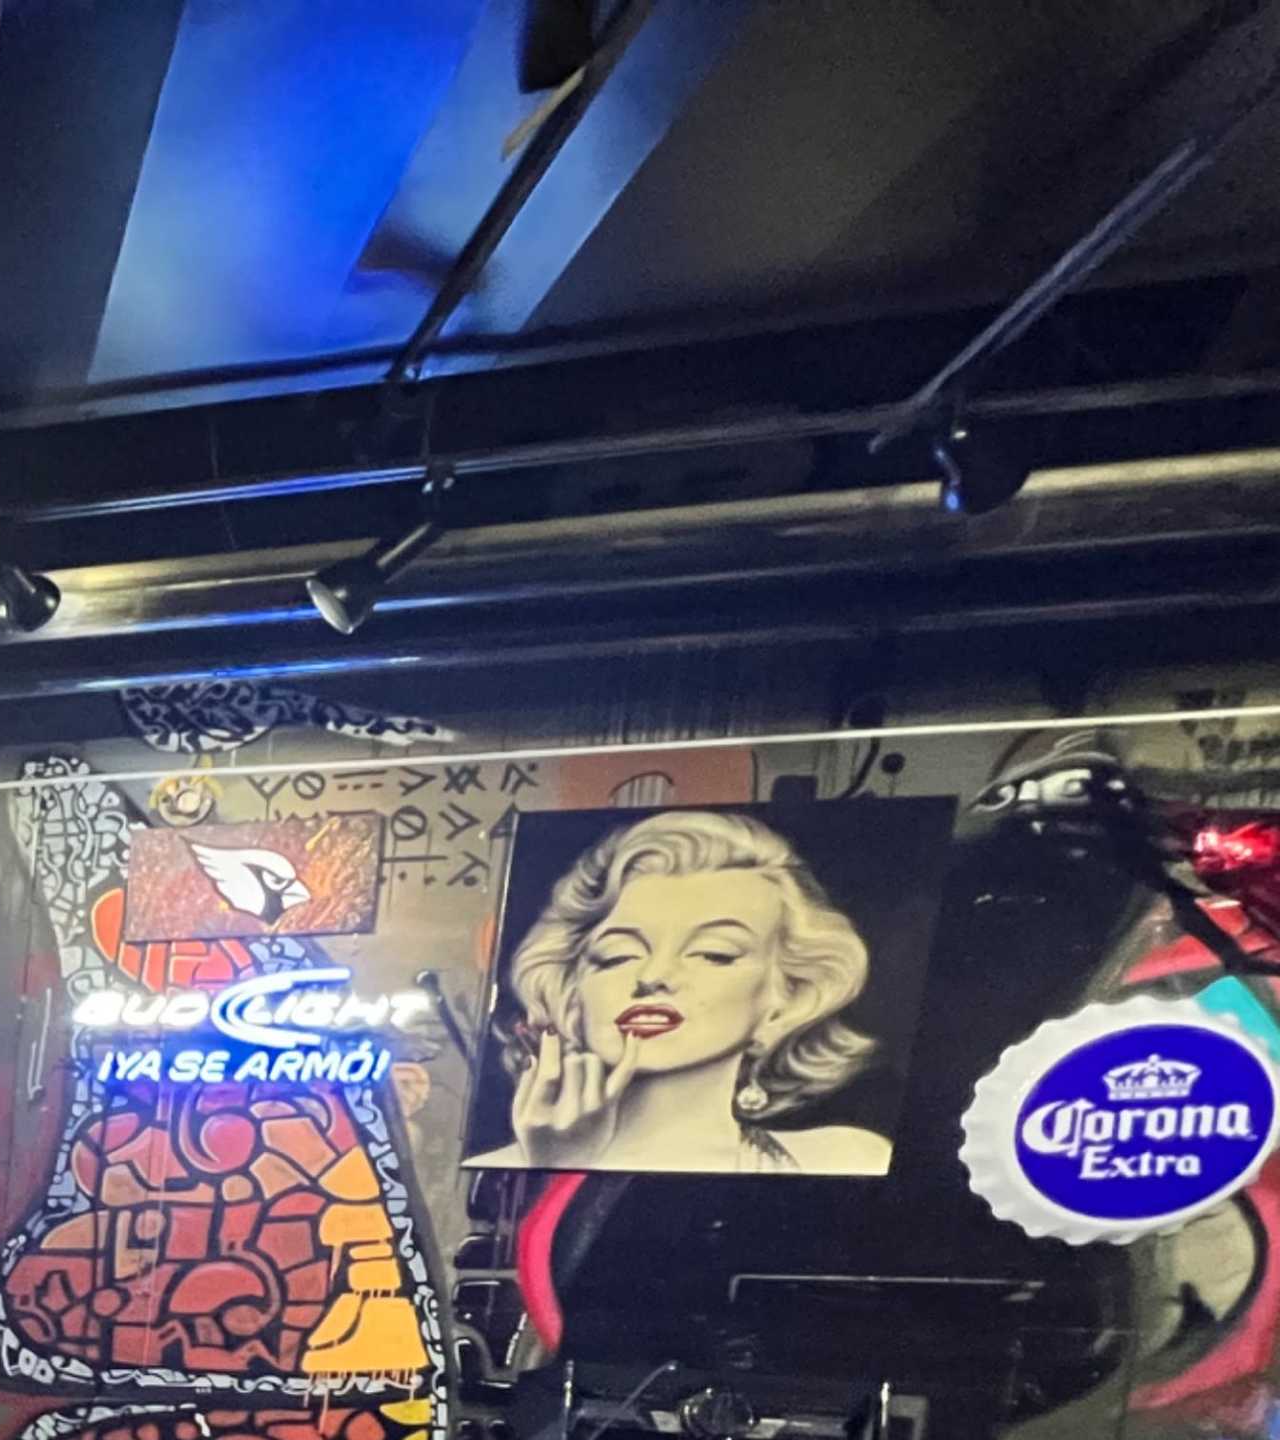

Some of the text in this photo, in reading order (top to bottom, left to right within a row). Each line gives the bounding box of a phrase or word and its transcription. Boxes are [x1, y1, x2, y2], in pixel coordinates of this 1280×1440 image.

[73, 993, 428, 1025] BUD LIGHT
[168, 1050, 231, 1082] SE
[234, 1040, 392, 1083] ARMÓ!
[1021, 1098, 1252, 1158] Corona
[1078, 1145, 1202, 1179] Extra
